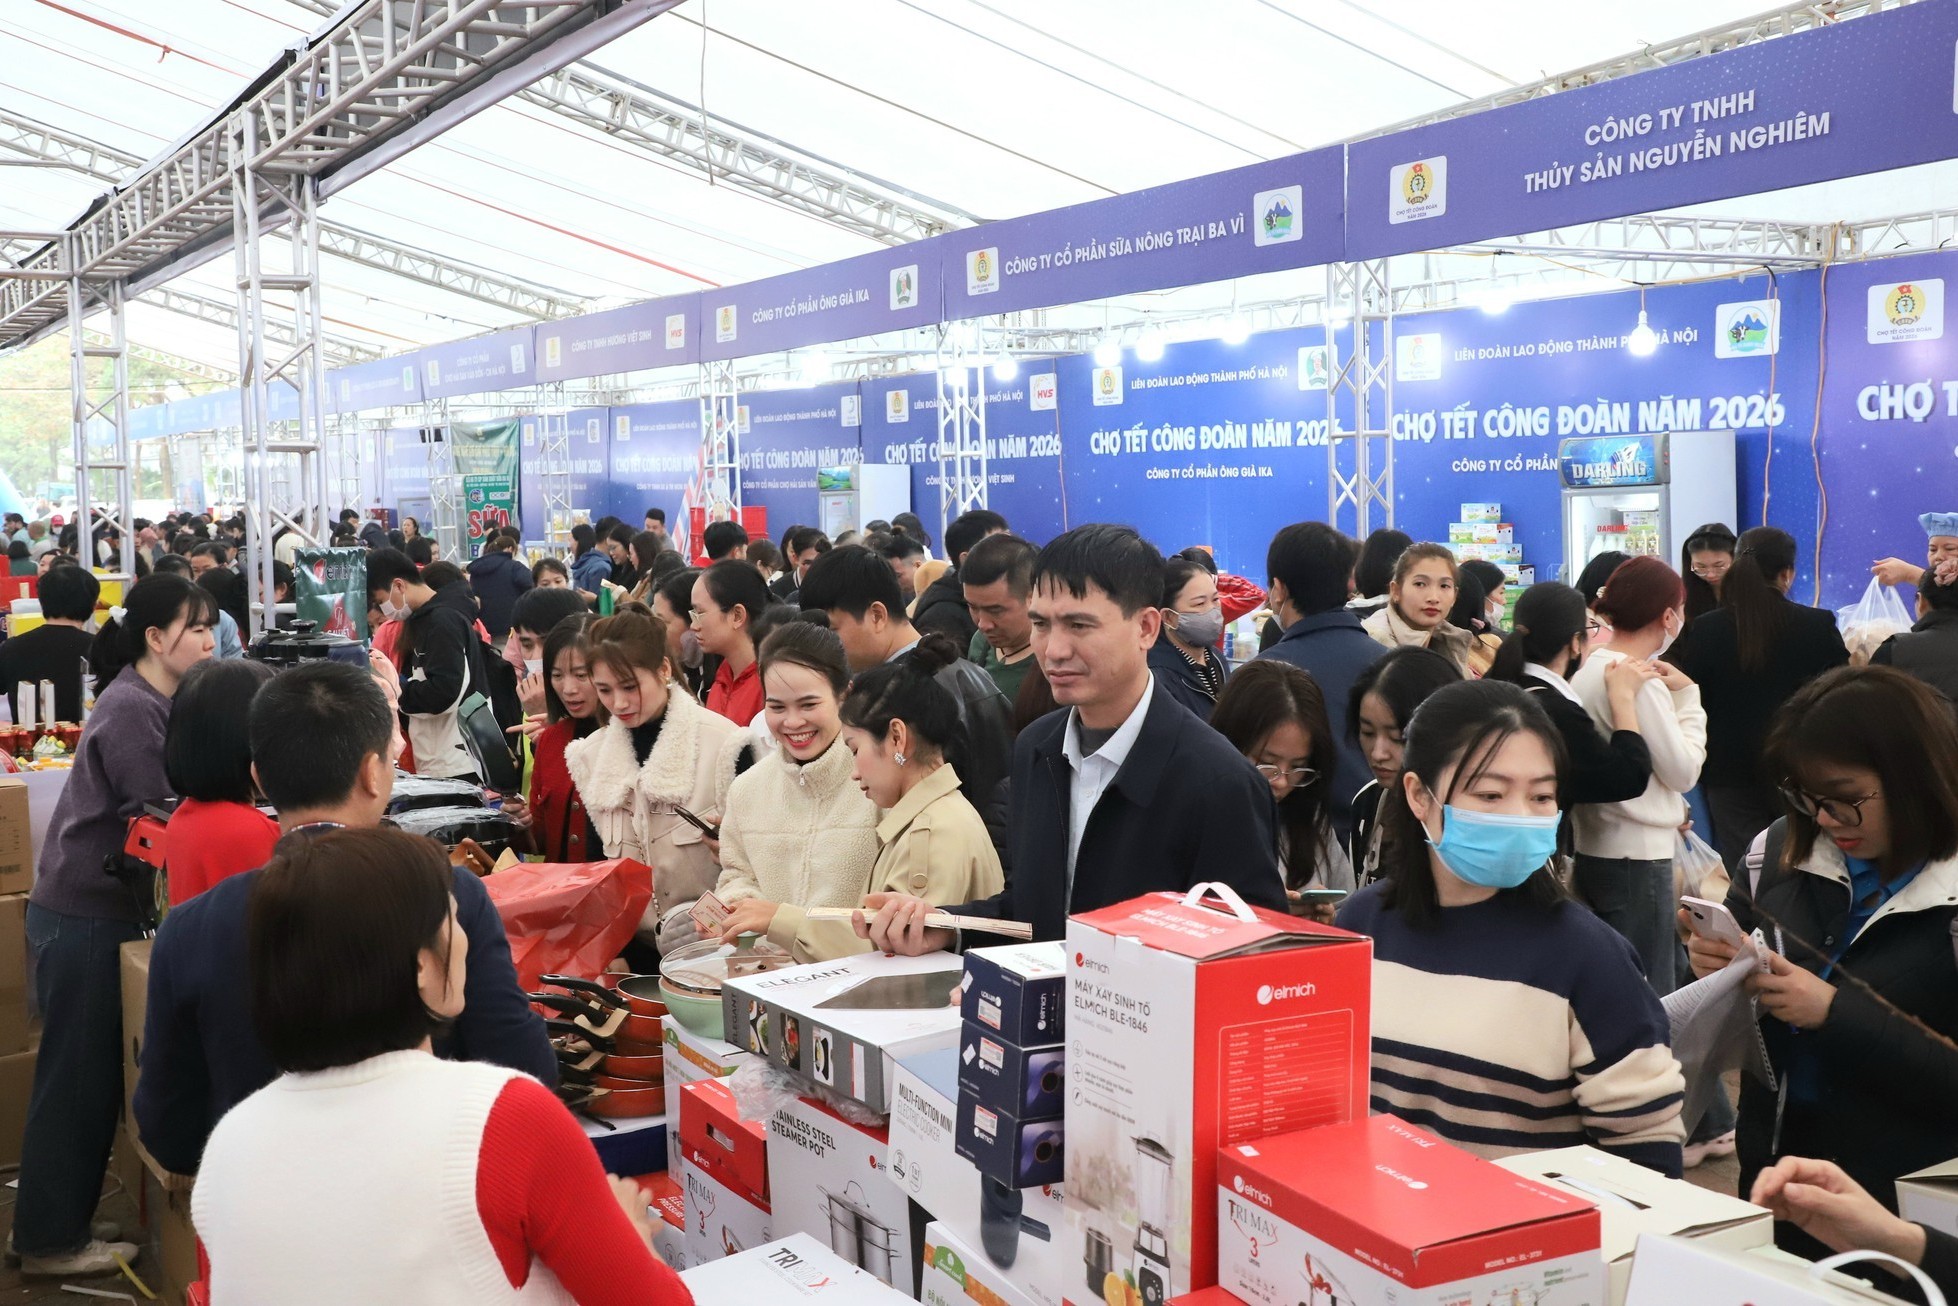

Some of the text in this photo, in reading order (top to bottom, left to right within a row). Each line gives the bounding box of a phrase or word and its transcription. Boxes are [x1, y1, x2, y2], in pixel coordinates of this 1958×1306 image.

[1585, 90, 1755, 146] CÔNG TY TNHH
[1525, 111, 1830, 193] THỦY SẢN NGUYỄN NGHIÊM
[1005, 212, 1245, 276] CÔNG TY CỔ PHẦN SỮA NÔNG TRẠI BA VÌ
[752, 289, 870, 324] CÔNG TY CỔ PHẦN ÔNG GIÀ IKA
[1455, 347, 1475, 361] LIÊN
[1478, 344, 1510, 360] ĐOÀN
[1513, 344, 1535, 357] LAO
[1538, 339, 1574, 357] ĐỘNG
[1577, 335, 1617, 351] THÀNH
[1673, 327, 1698, 345] NỘI
[1131, 365, 1288, 389] LIÊN ĐOÀN LAO ĐỘNG THÀNH PHỐ HÀ NỘI
[989, 391, 1001, 404] PHỐ
[1002, 390, 1011, 402] HÀ
[1037, 388, 1054, 399] HVS
[1856, 379, 1934, 422] CHỢ
[1393, 393, 1786, 443] CHỢ TẾT CÔNG ĐOÀN NĂM 2026
[885, 434, 1062, 465] CHỢ TẾT NĂM 2026
[1090, 428, 1121, 456] CHỢ
[1124, 422, 1148, 453] TẾT
[1151, 423, 1196, 451] CÔNG
[1200, 420, 1247, 450] ĐOÀN
[1251, 418, 1292, 448] NĂM
[739, 451, 750, 472] HỢ
[751, 447, 765, 470] TẾT
[766, 448, 789, 469] CÔNG
[791, 447, 816, 468] ĐOÀN
[818, 445, 839, 466] NĂM
[1146, 463, 1273, 480] CÔNG TY CỔ PHẦN ÔNG GIÀ IKA
[1452, 453, 1558, 472] CÔNG TY CỔ PHẦN
[1572, 461, 1647, 479] DARLING
[1001, 474, 1015, 484] SINH
[1597, 524, 1629, 533] DARLING
[756, 967, 851, 989] ELEGANT
[1085, 959, 1110, 974] elmich
[1075, 978, 1093, 995] MÁY
[1096, 986, 1112, 1001] XAY
[1115, 993, 1135, 1011] SINH
[1274, 981, 1315, 1000] elmich
[1075, 996, 1107, 1018] ELMICH
[1110, 1009, 1147, 1033] BLE-1846
[899, 1083, 940, 1124] MULTI-FUNCTION
[940, 1113, 953, 1134] MINI
[771, 1120, 825, 1158] STEAMER POT
[775, 1110, 836, 1150] TAINLESS STEEL
[687, 1173, 716, 1205] TRI MAX
[1245, 1184, 1272, 1207] elmich
[699, 1211, 705, 1229] 3
[1228, 1199, 1278, 1237] TRI MAX
[1250, 1237, 1258, 1258] 3
